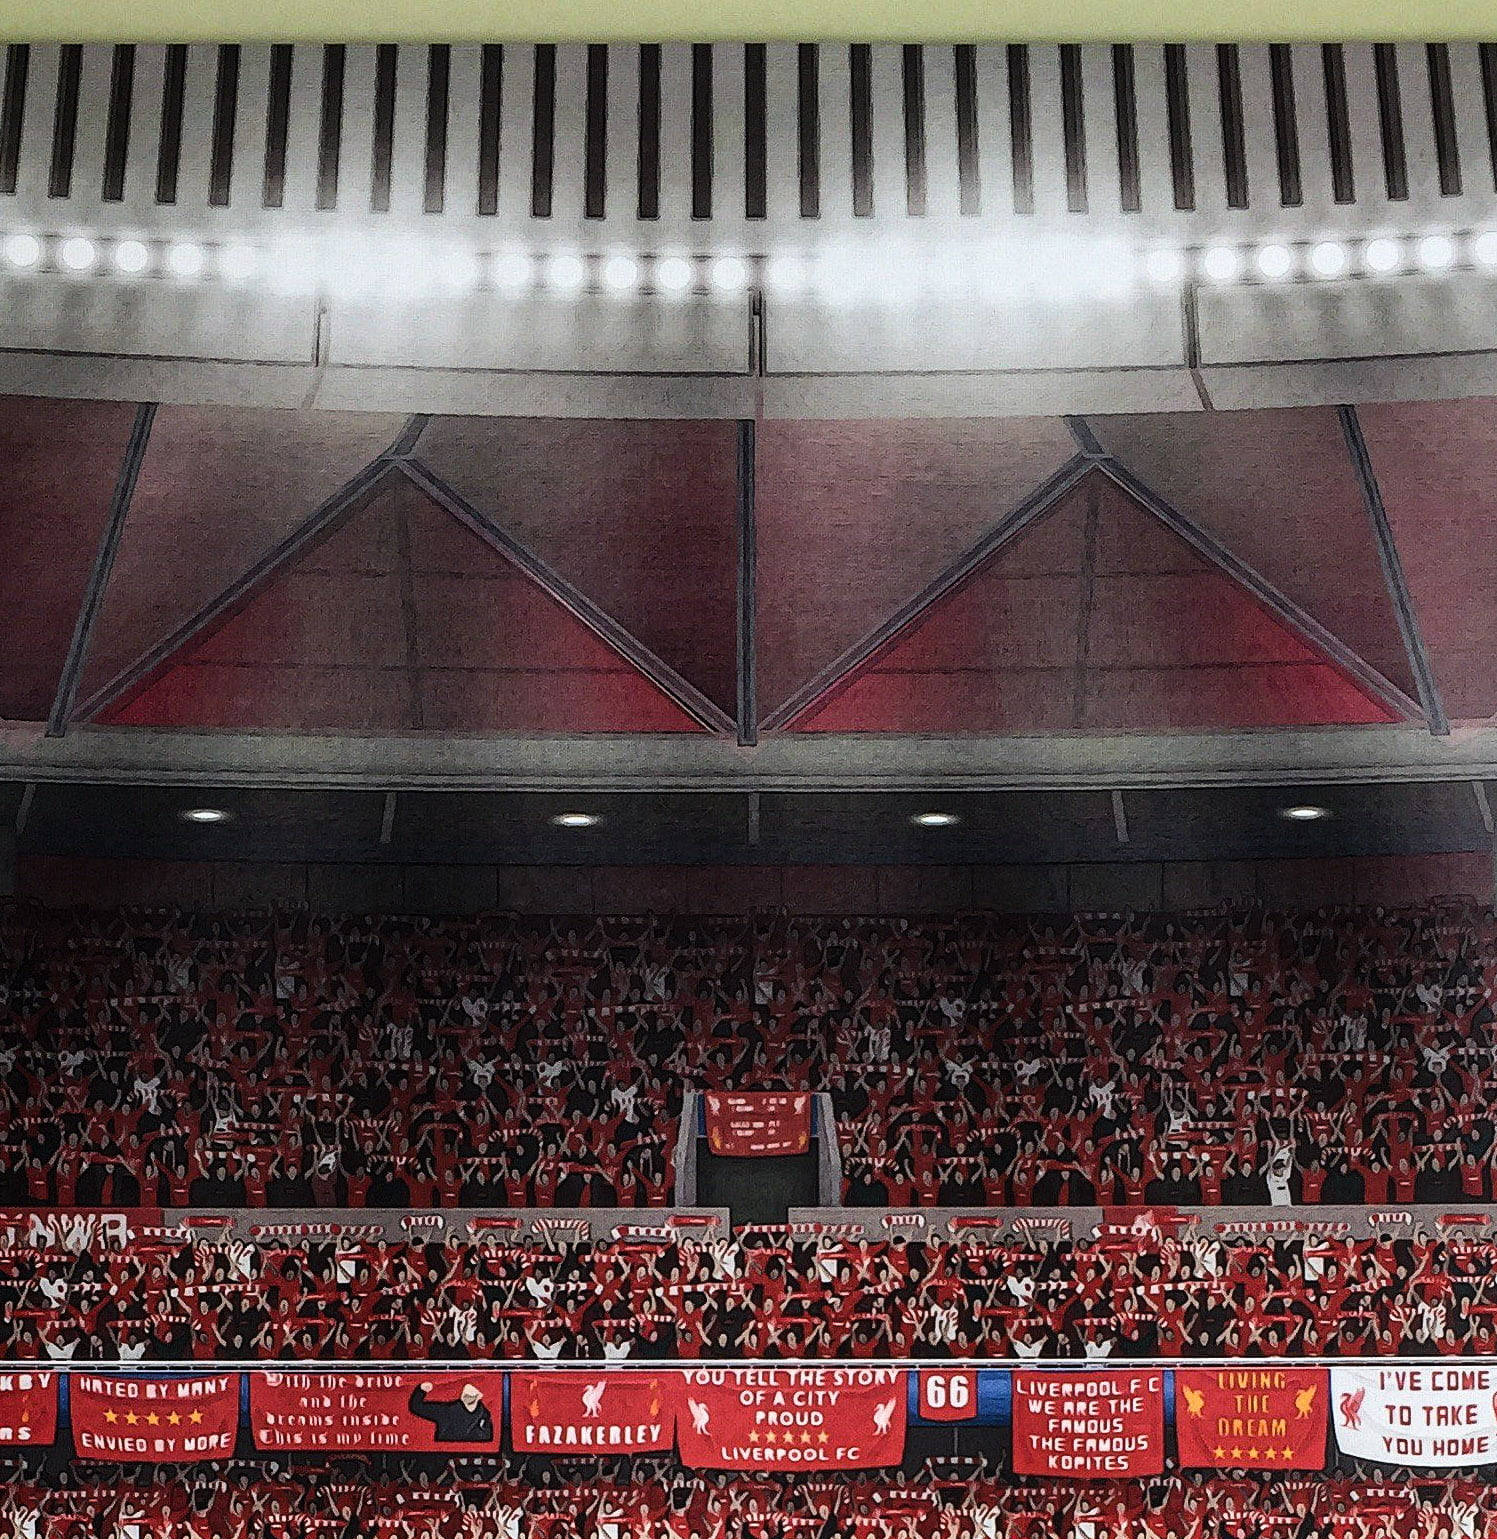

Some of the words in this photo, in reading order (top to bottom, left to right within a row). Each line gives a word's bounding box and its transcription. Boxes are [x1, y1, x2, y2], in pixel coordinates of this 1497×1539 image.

[80, 1376, 139, 1398] HATED
[146, 1383, 169, 1399] BY
[178, 1376, 229, 1398] MANY
[319, 1373, 349, 1390] the
[354, 1375, 403, 1388] drive
[682, 1370, 725, 1387] YOU
[734, 1370, 780, 1387] TELL
[787, 1370, 827, 1387] THE
[834, 1370, 899, 1387] STORY
[1017, 1377, 1124, 1396] LIVERPOOL
[1217, 1372, 1287, 1389] LIVING
[1380, 1371, 1421, 1391] I'VE
[1431, 1371, 1489, 1390] COME
[299, 1393, 332, 1408] and
[341, 1393, 367, 1409] the
[740, 1391, 767, 1407] OF
[772, 1391, 786, 1407] A
[793, 1389, 840, 1407] CITY
[926, 1376, 968, 1408] 66
[1028, 1399, 1057, 1414] WE
[1063, 1399, 1106, 1414] ARE
[1110, 1398, 1144, 1413] THE
[1233, 1395, 1270, 1413] THE
[266, 1412, 335, 1428] dreams
[341, 1412, 401, 1428] inside
[755, 1410, 825, 1427] PROUD
[1384, 1405, 1413, 1426] TO
[1422, 1405, 1478, 1426] TAKE
[525, 1423, 662, 1446] FAZAKERLEY
[1049, 1418, 1124, 1433] FAMOUS
[1218, 1418, 1287, 1437] DREAM
[82, 1433, 147, 1452] ENVIED
[155, 1437, 176, 1452] BY
[184, 1432, 232, 1451] MORE
[258, 1428, 306, 1445] This
[312, 1432, 328, 1445] is
[336, 1433, 361, 1448] my
[366, 1431, 410, 1447] time
[1029, 1434, 1067, 1451] THE
[1073, 1435, 1149, 1452] FAMOUS
[1382, 1437, 1425, 1455] YOU
[1433, 1435, 1489, 1456] HOME
[722, 1445, 830, 1462] LIVERPOOL
[836, 1445, 860, 1461] FC
[1048, 1454, 1129, 1471] KOPITES
